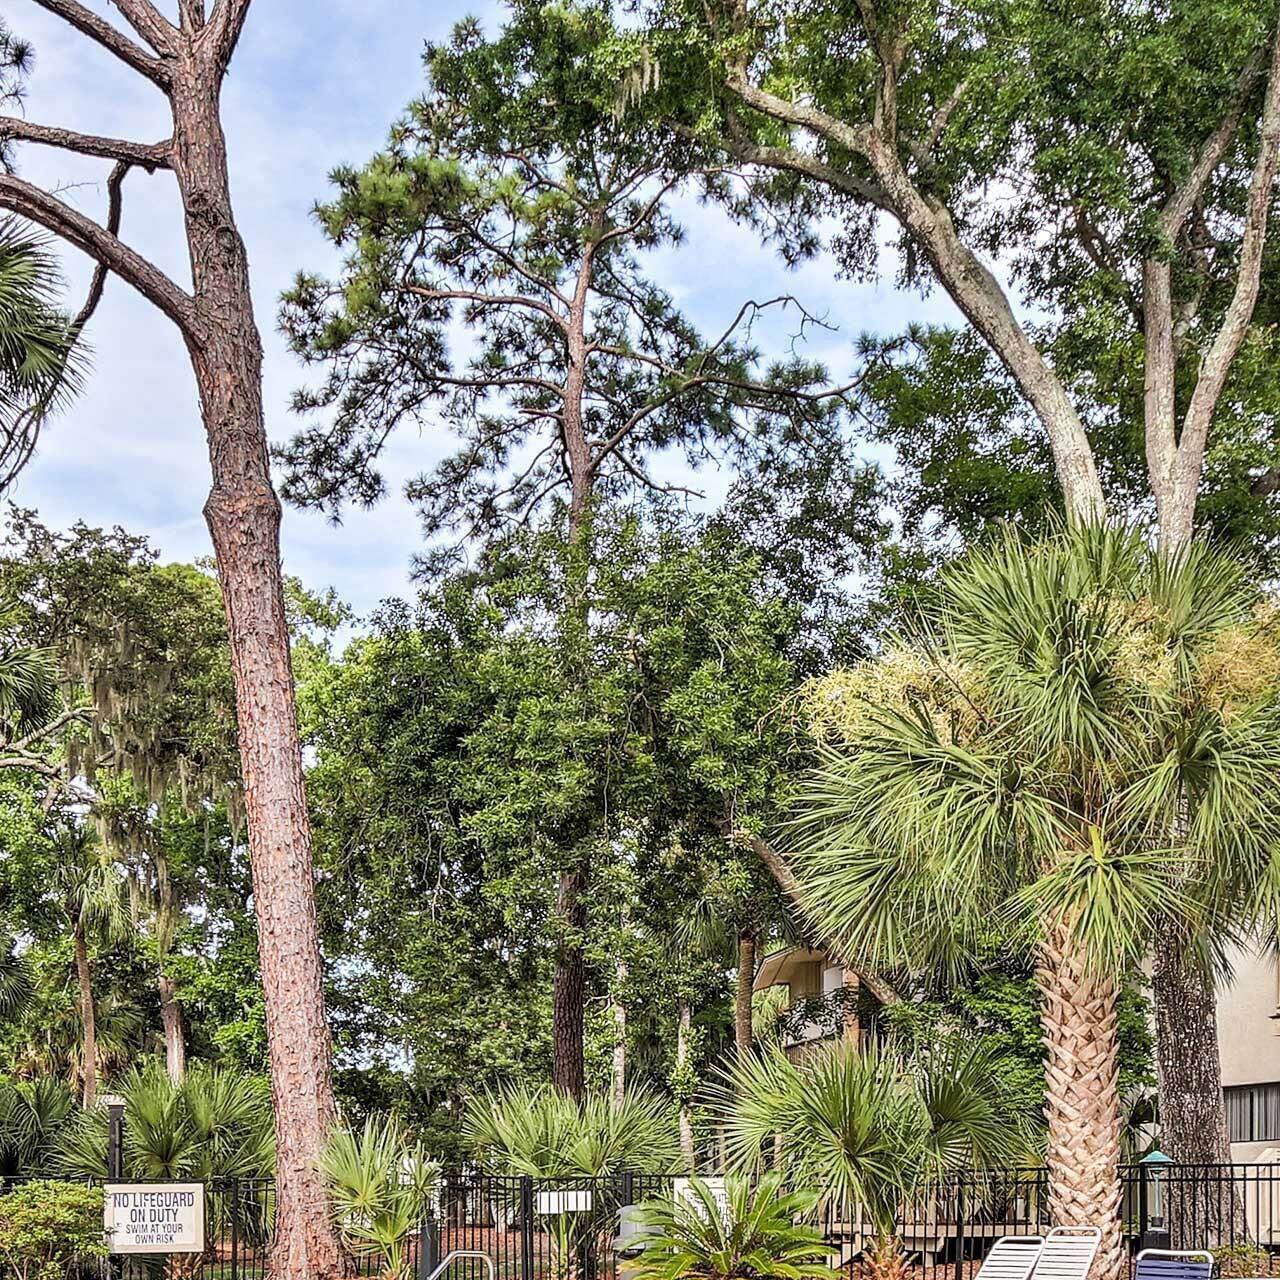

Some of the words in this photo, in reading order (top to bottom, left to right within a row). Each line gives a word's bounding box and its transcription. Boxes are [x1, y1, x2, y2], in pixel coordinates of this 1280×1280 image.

[113, 1193, 129, 1208] NO
[133, 1192, 195, 1207] LIFEGUARD
[130, 1208, 146, 1223] ON
[150, 1208, 179, 1223] DUTY
[126, 1224, 148, 1234] SWIM
[150, 1224, 160, 1234] AT
[162, 1223, 183, 1233] YOUR
[135, 1234, 154, 1244] OWN
[156, 1234, 174, 1244] RISK
